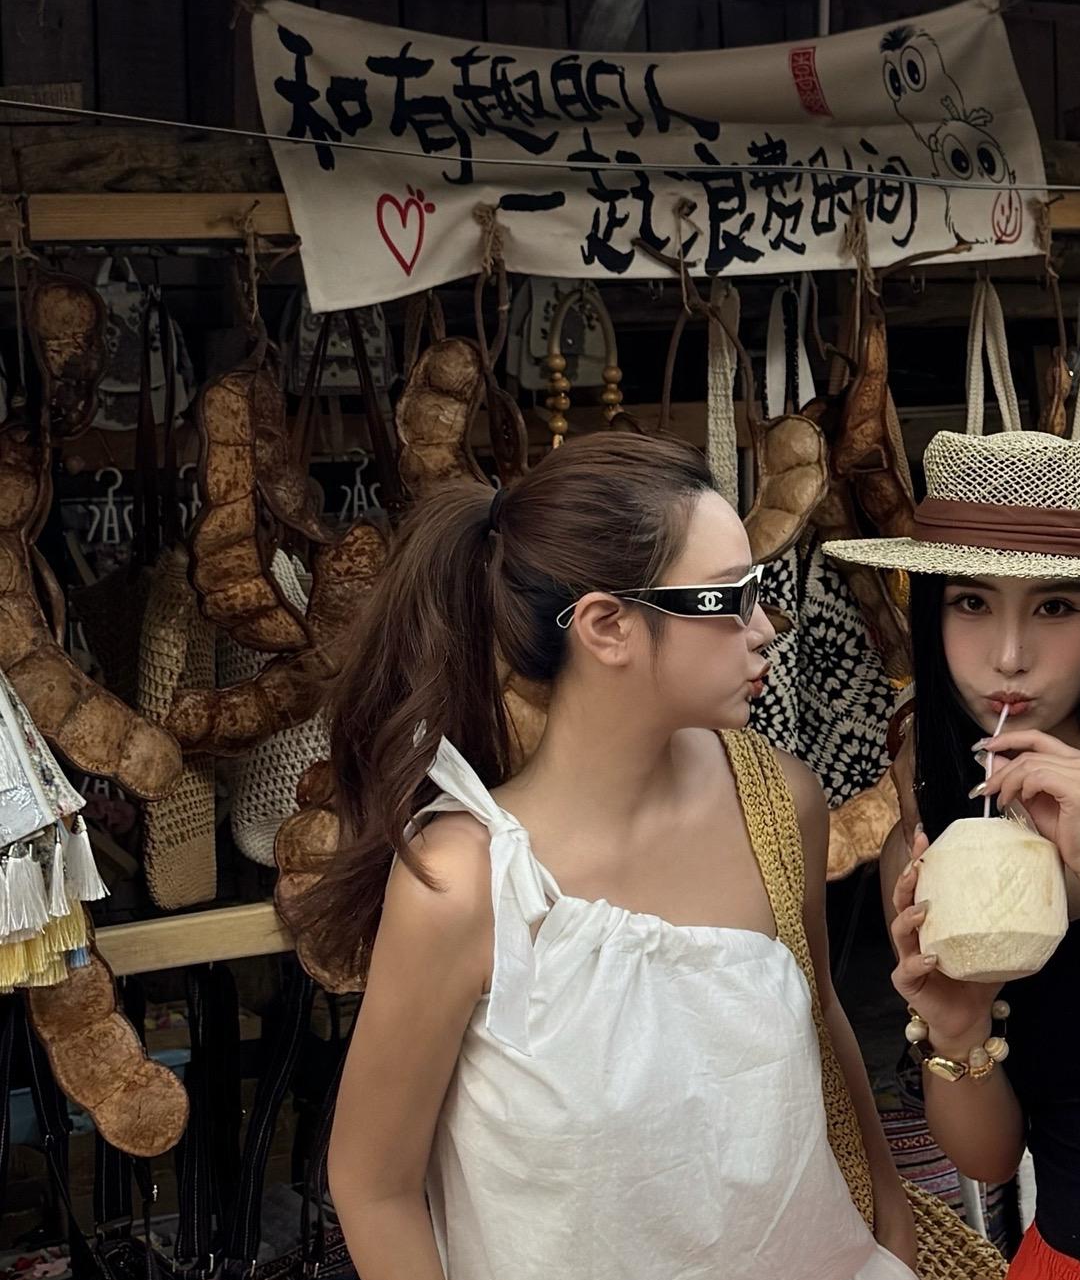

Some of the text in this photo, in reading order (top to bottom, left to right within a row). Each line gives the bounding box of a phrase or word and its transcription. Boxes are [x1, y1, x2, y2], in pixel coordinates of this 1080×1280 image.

[274, 24, 720, 184] 和有趣的人
[497, 129, 920, 275] 一起浪费时间
